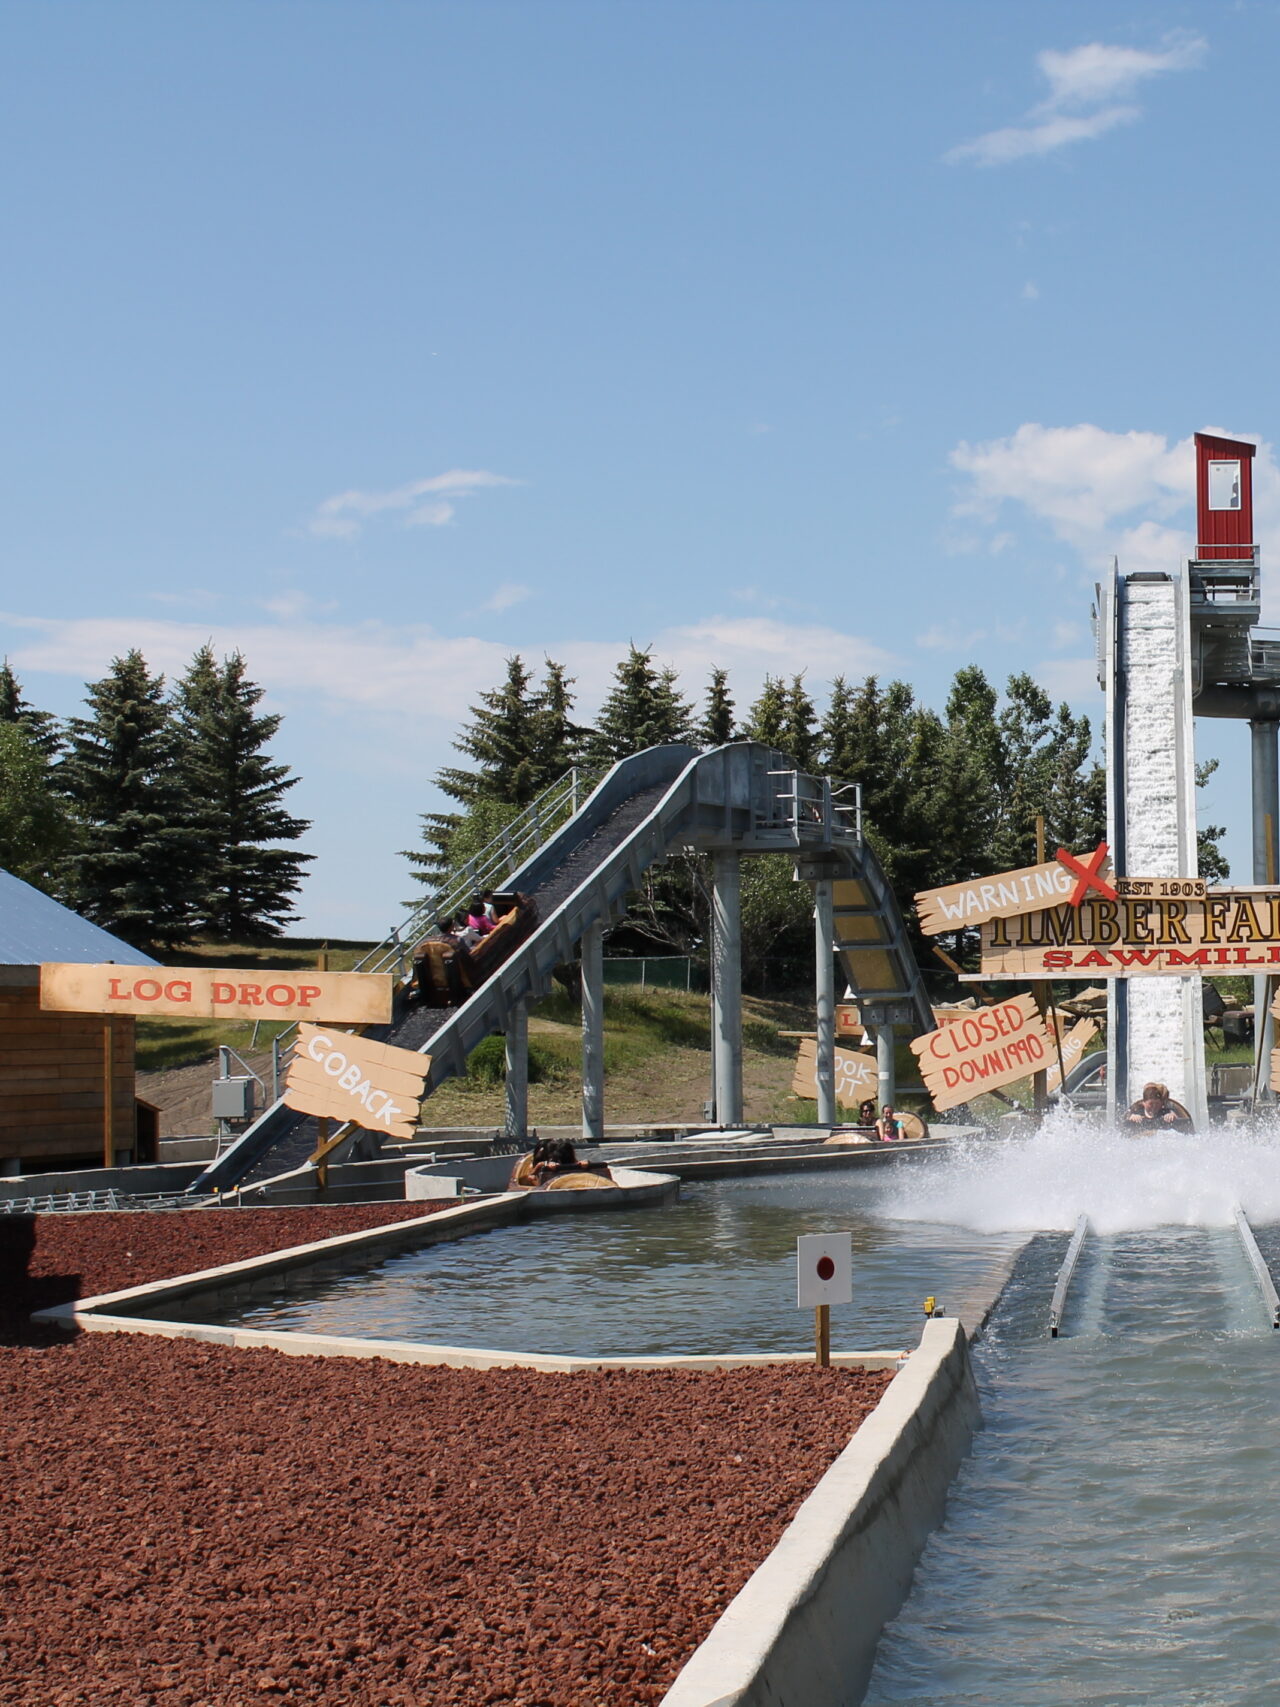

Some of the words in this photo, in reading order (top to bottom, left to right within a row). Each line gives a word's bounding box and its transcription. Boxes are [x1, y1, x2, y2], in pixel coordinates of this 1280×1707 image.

[937, 867, 1072, 920] WARNING
[1119, 881, 1153, 896] EST
[1160, 882, 1205, 897] 1903
[108, 978, 192, 1003] LOG
[210, 981, 321, 1008] DROP
[929, 1004, 1024, 1059] CLOSED
